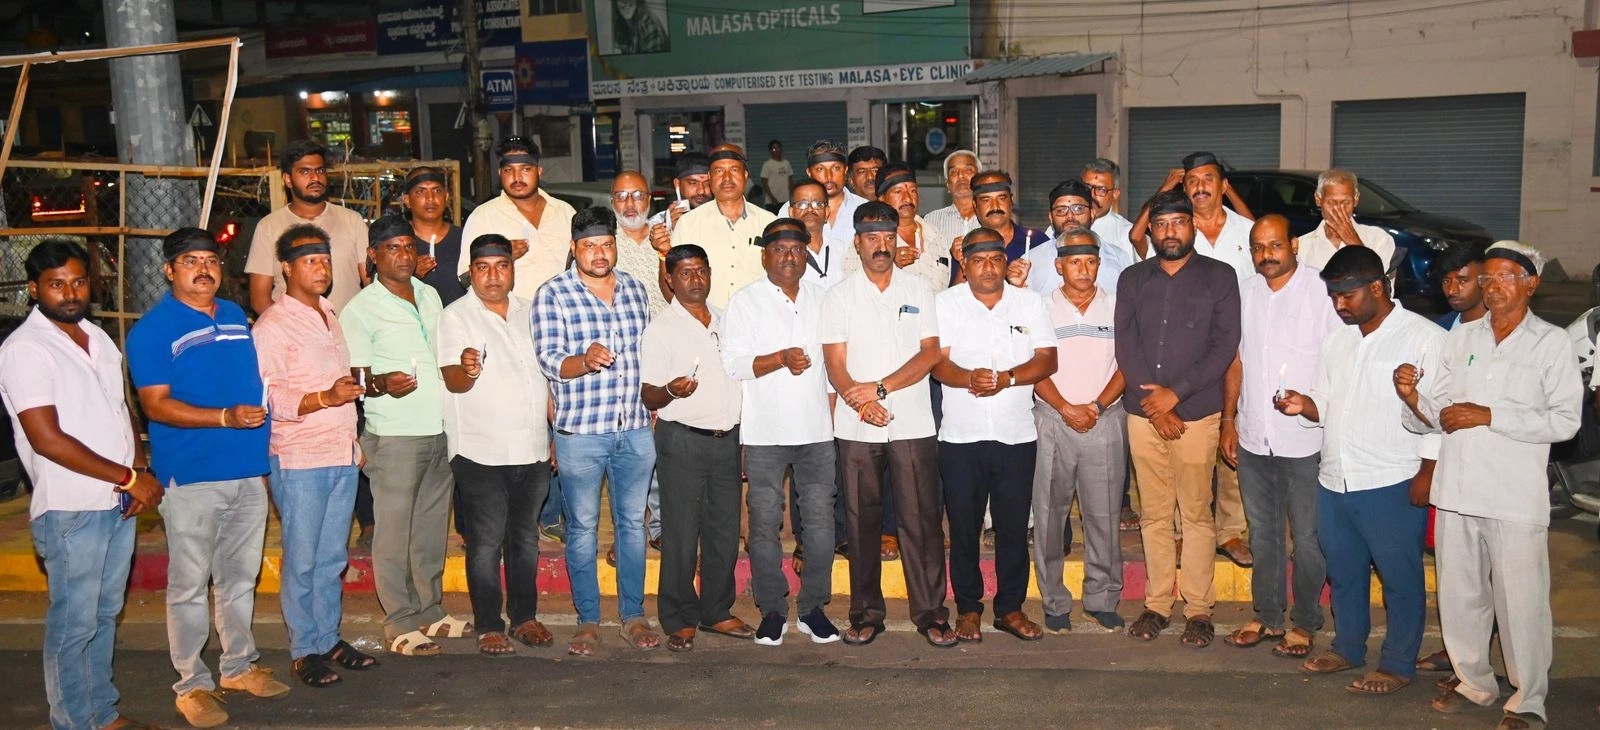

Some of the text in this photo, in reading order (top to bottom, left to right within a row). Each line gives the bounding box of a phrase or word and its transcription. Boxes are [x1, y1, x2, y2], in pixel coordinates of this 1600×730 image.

[686, 3, 841, 37] MALASA OPTICALS
[714, 72, 833, 90] COMPUTERISED EYE TESTING
[839, 63, 971, 84] MALASA EYE CLINIC
[486, 79, 513, 93] ATM
